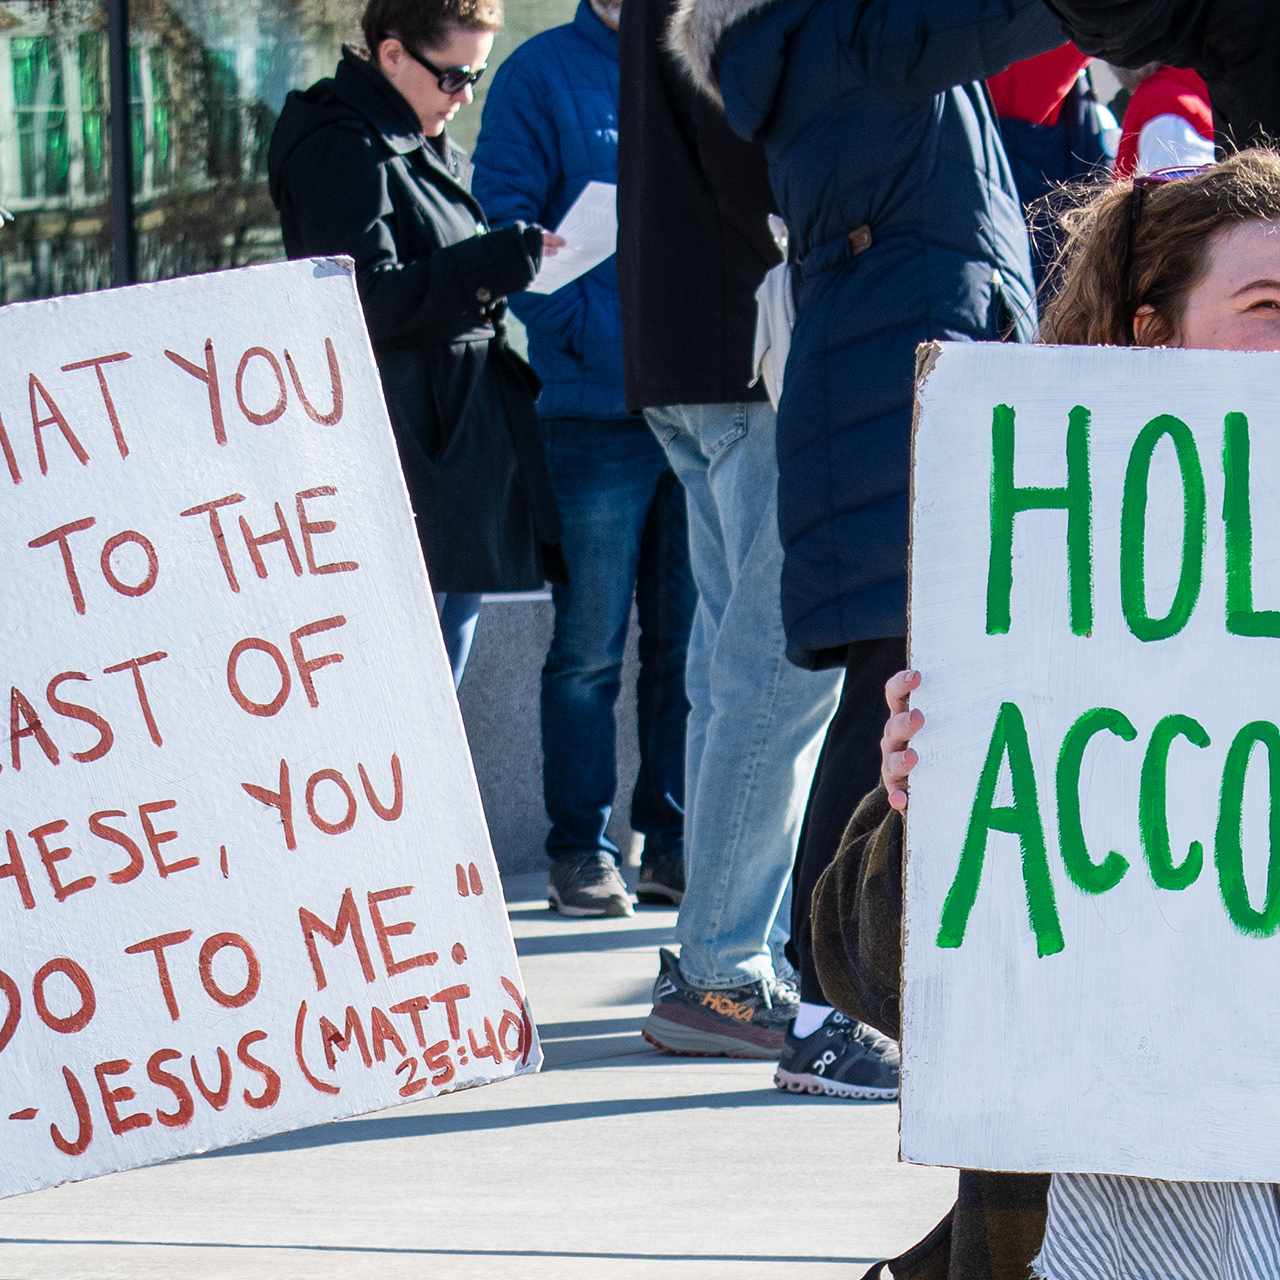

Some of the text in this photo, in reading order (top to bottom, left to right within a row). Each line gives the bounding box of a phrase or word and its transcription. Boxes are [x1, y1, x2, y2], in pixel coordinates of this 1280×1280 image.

[165, 338, 343, 445] YOU
[28, 517, 159, 615] TO
[180, 487, 359, 593] THE
[227, 615, 347, 717] OF
[241, 753, 404, 851] YOU
[125, 929, 261, 1021] TO
[701, 991, 756, 1023] HOKA
